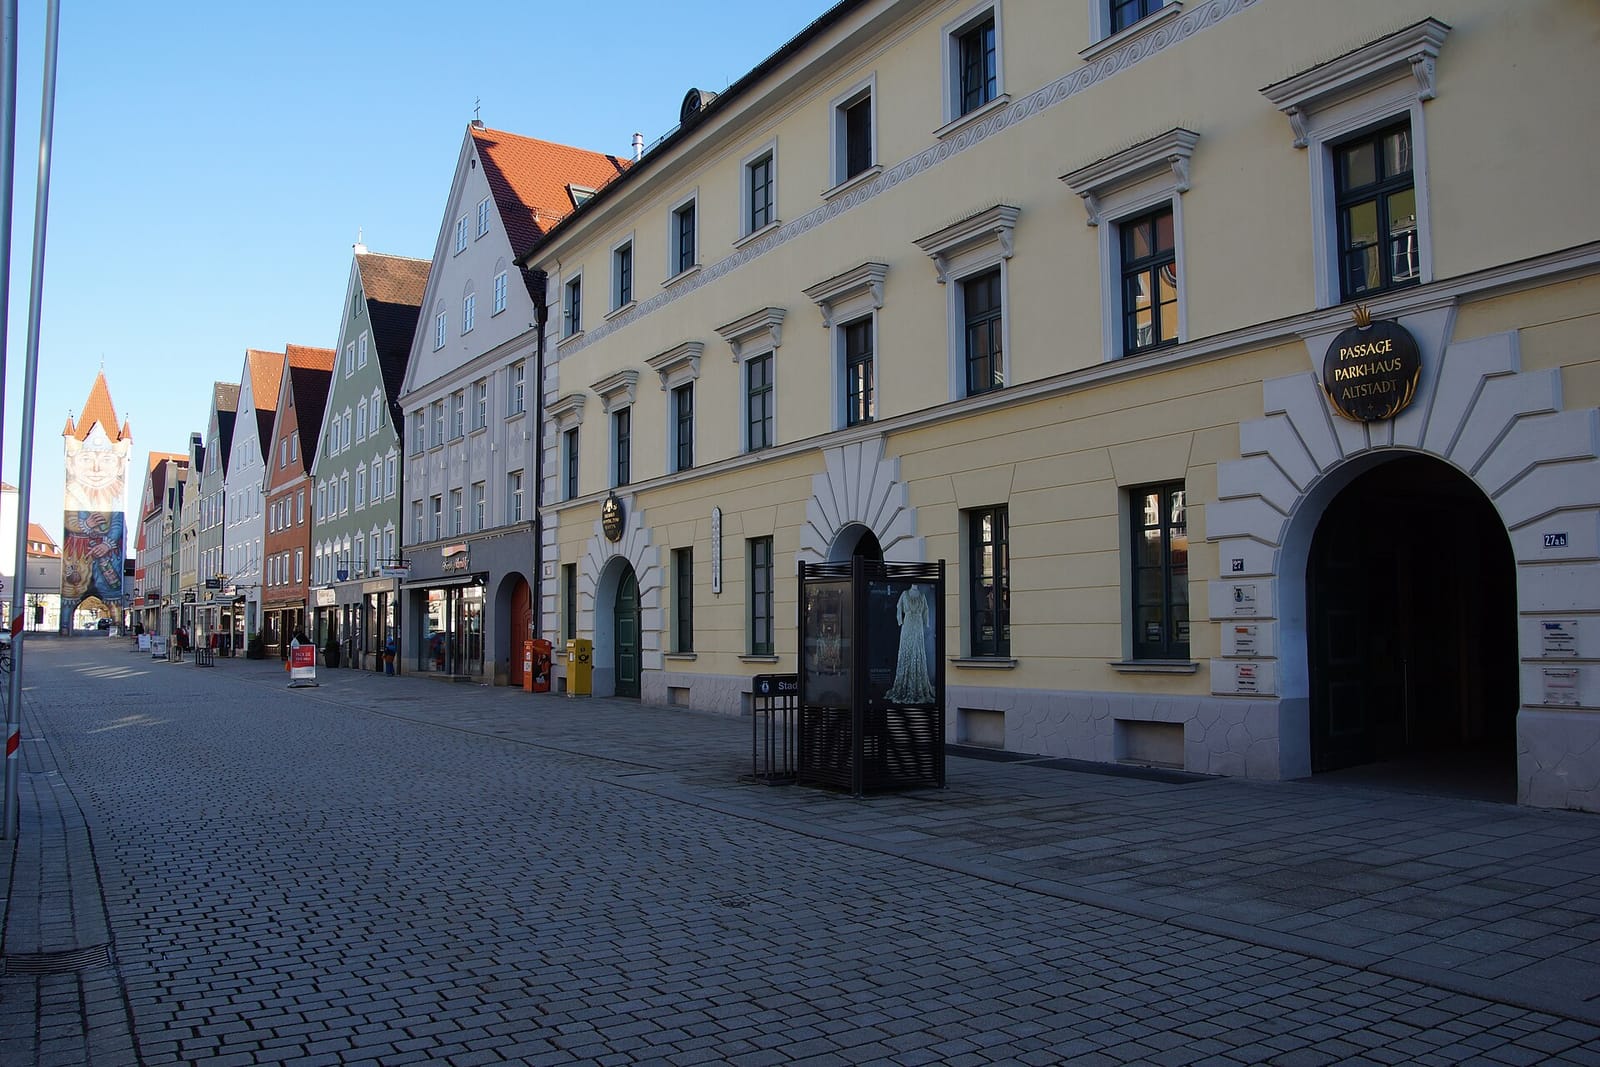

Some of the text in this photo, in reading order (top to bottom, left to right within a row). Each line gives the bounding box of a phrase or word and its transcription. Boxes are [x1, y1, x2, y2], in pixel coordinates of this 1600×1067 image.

[1340, 339, 1393, 360] PASSAGE
[1334, 357, 1402, 381] PARKHAUS
[1342, 379, 1398, 400] ALTSTADT
